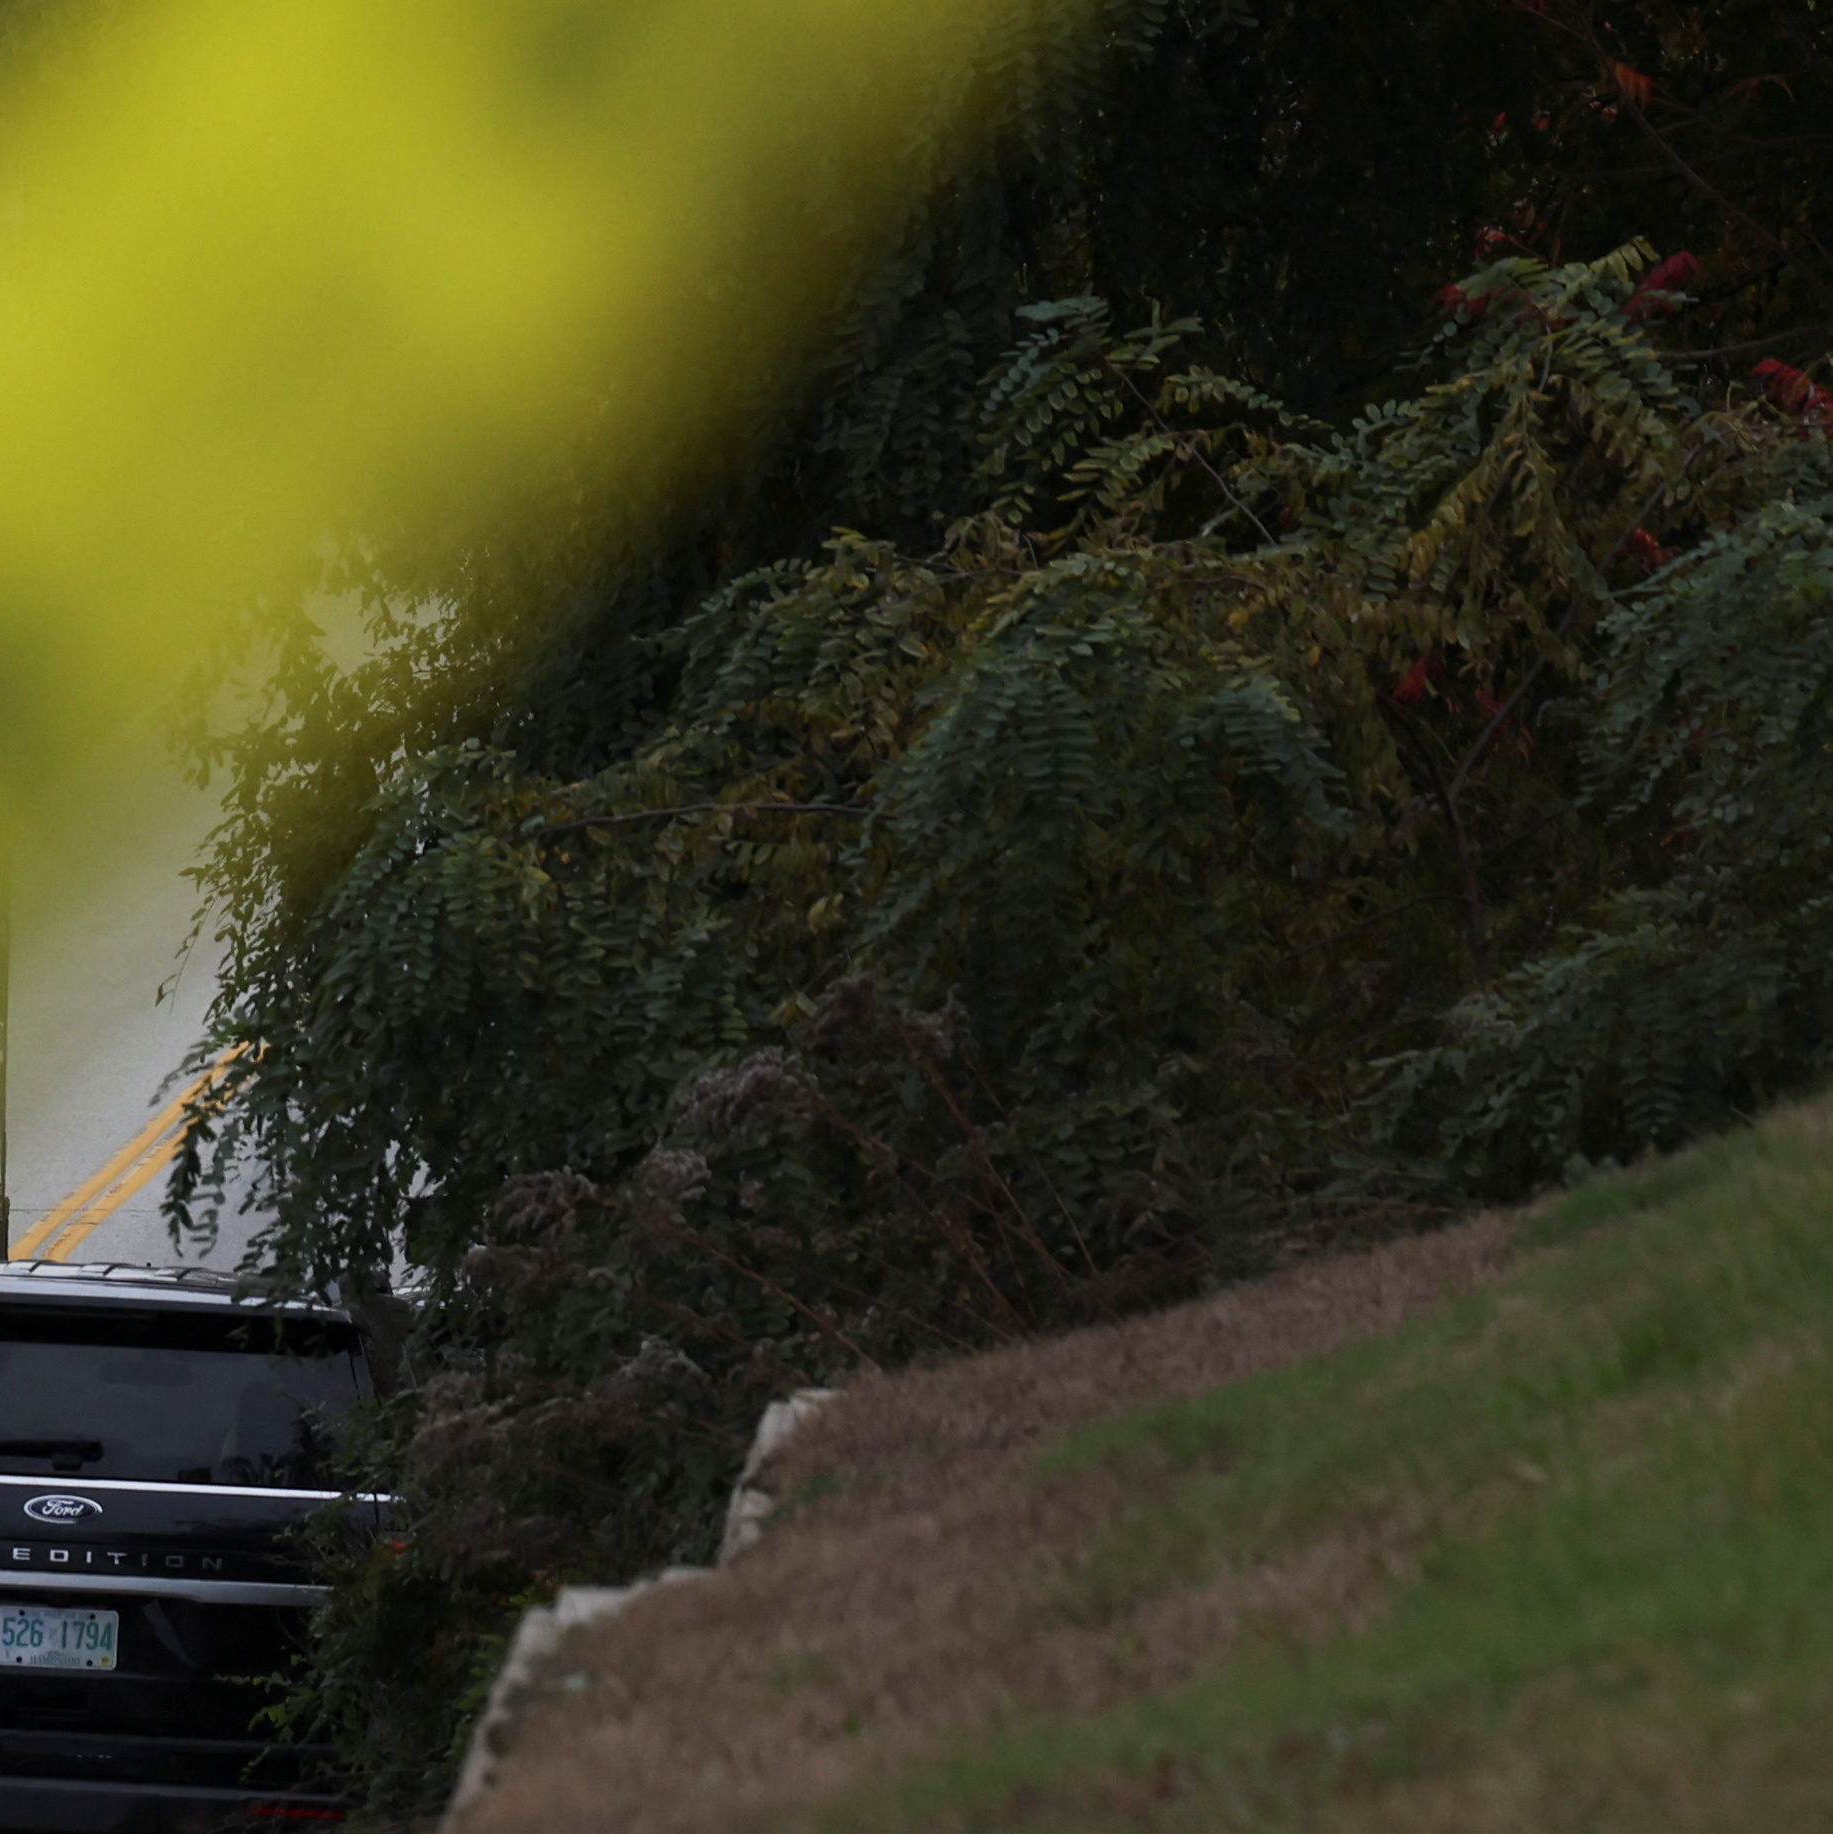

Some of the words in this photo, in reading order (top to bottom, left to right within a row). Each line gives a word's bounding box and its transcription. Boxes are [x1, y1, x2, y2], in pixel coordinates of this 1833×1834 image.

[42, 1500, 84, 1517] Ford
[1, 1616, 44, 1648] 526
[60, 1620, 115, 1652] 1794
